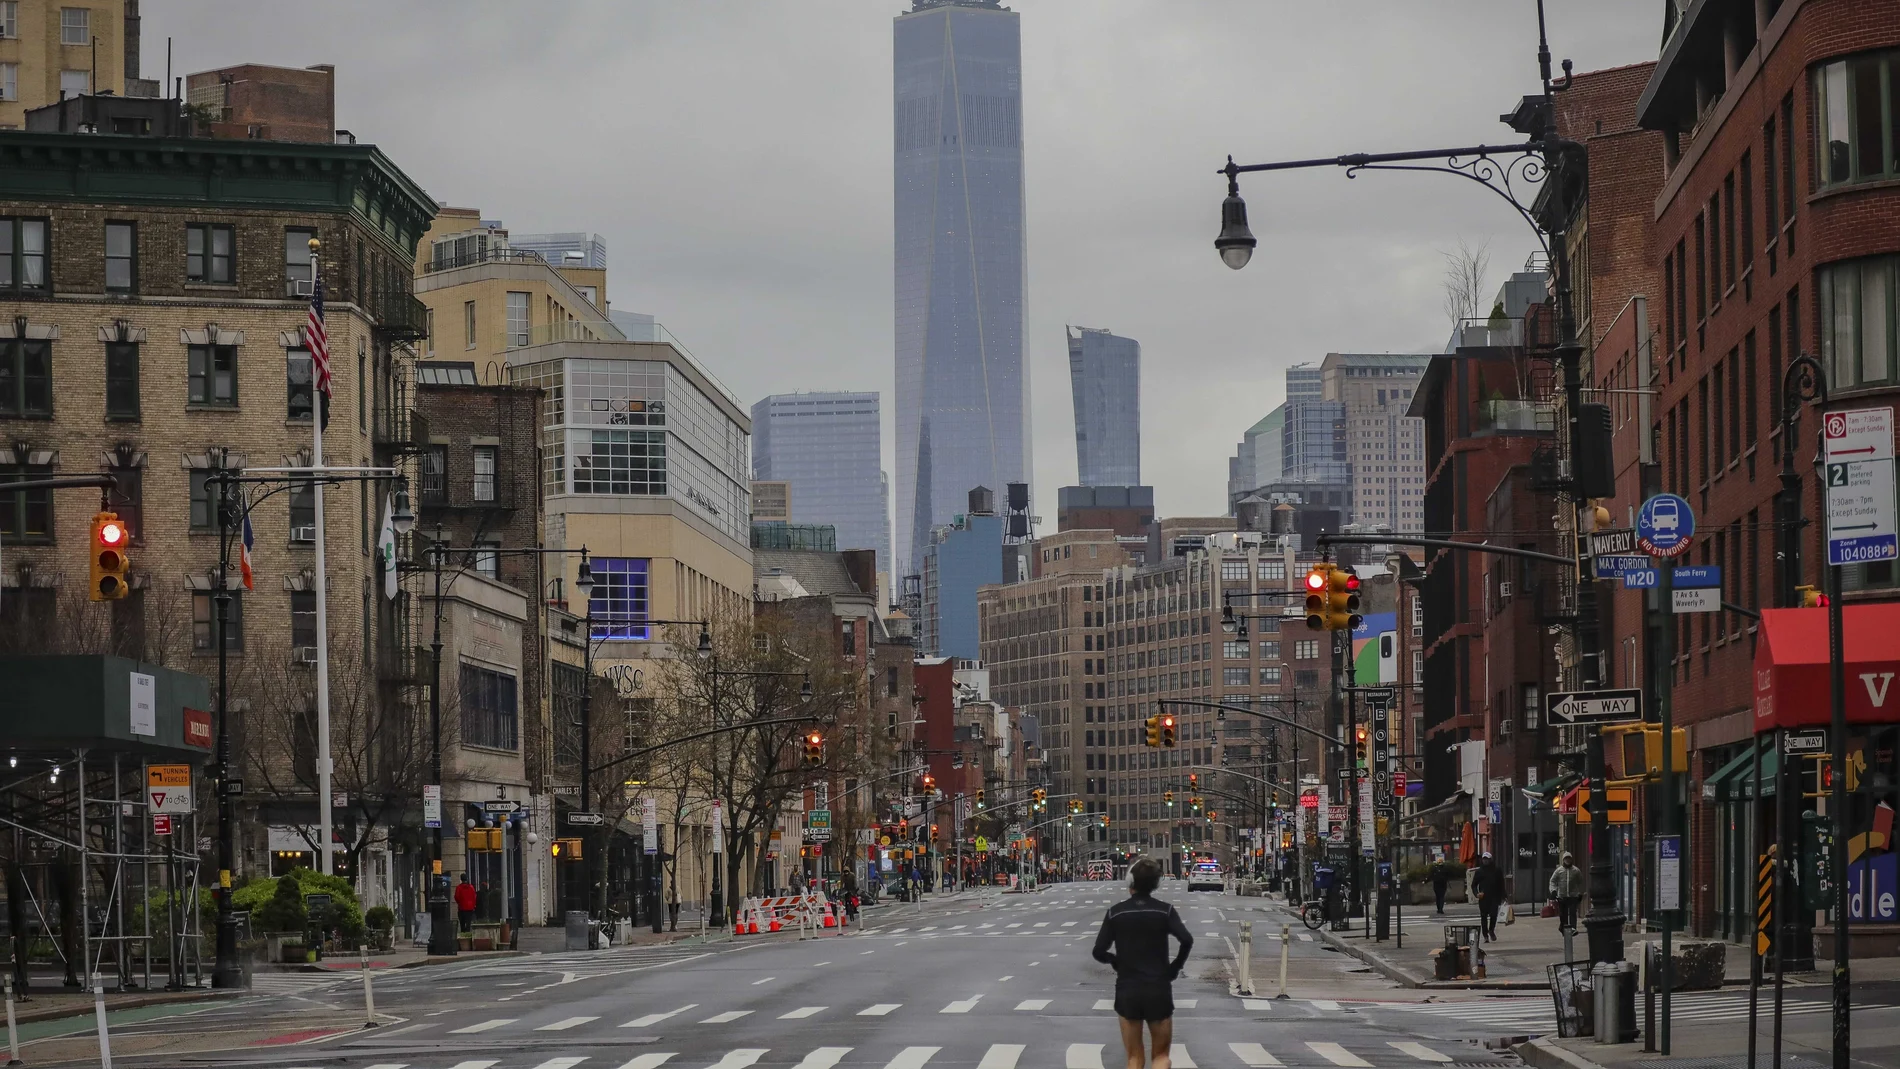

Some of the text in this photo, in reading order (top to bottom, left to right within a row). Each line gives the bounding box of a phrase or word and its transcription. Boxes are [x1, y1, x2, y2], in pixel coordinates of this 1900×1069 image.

[1867, 425, 1885, 433] Sunday
[1832, 464, 1844, 485] 2
[1850, 479, 1871, 487] parking
[1831, 498, 1855, 506] 7:30am
[1860, 496, 1874, 504] 7pm
[1831, 507, 1878, 517] Except Sunday
[1593, 532, 1631, 554] WAVERLY
[1641, 539, 1652, 551] NO
[1652, 537, 1689, 560] STANDING
[1840, 544, 1880, 561] 104088
[1598, 557, 1648, 570] MAX GORDON
[1626, 571, 1655, 586] M20
[1692, 569, 1707, 578] Ferry
[1562, 699, 1630, 715] ONE WAY
[1805, 737, 1821, 747] WAY
[552, 787, 573, 795] CHARLES
[1490, 791, 1500, 800] 20
[1382, 868, 1388, 876] P
